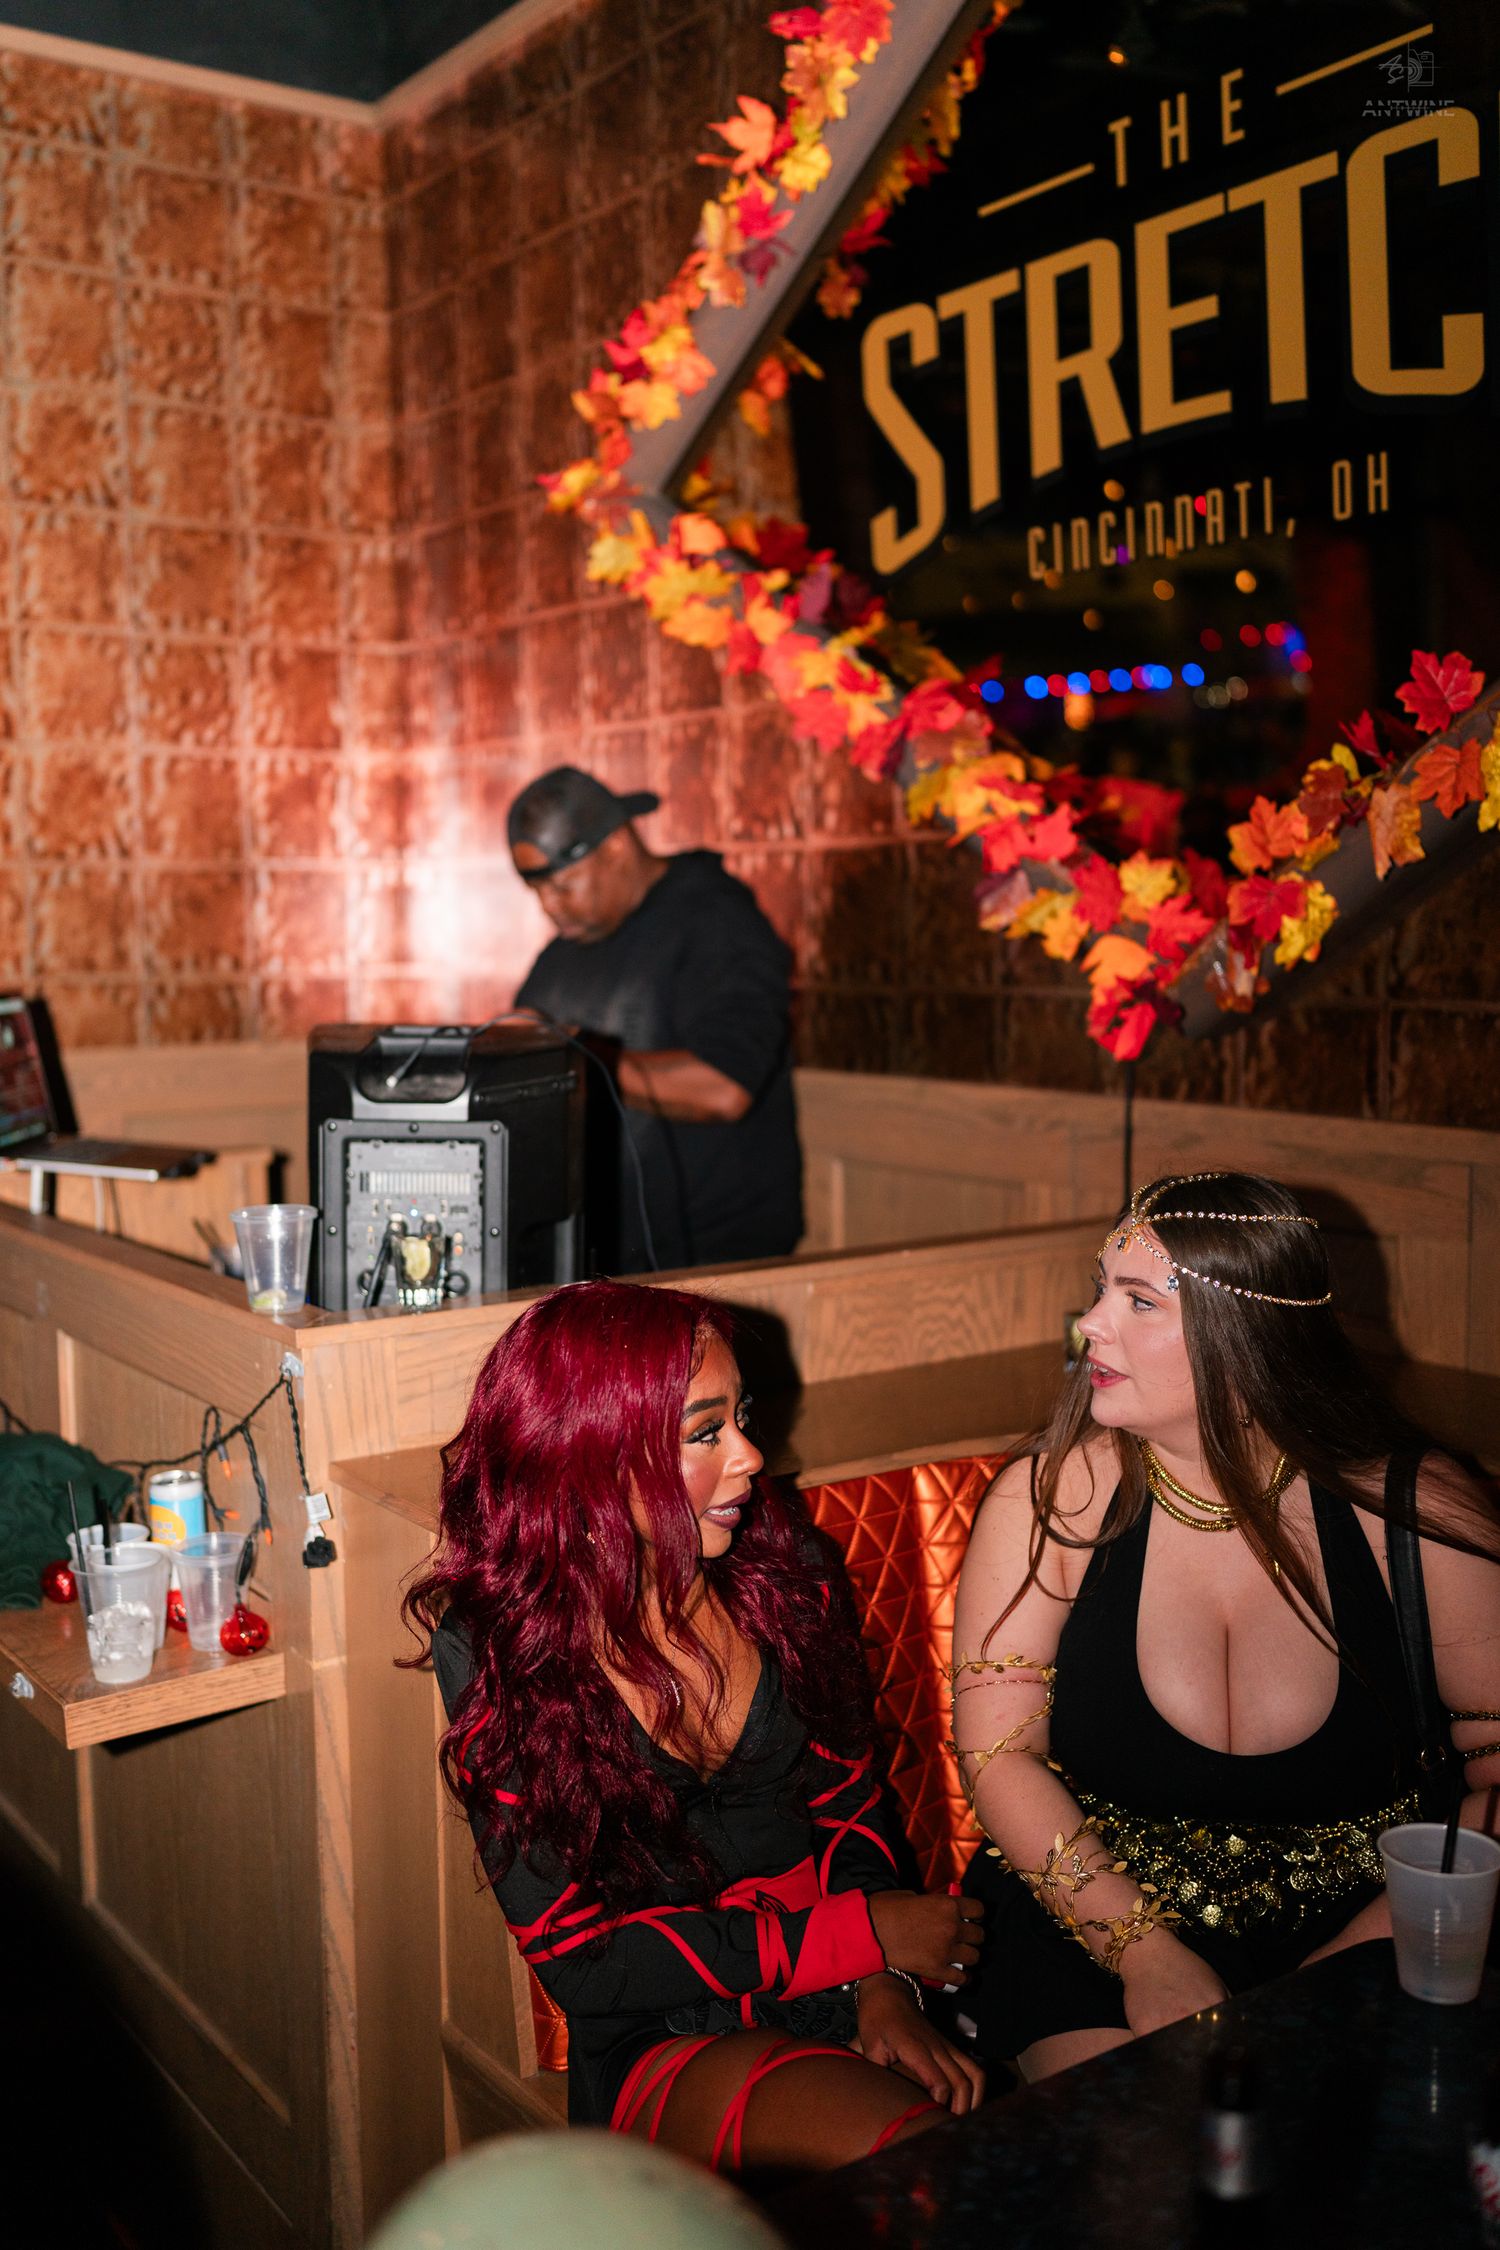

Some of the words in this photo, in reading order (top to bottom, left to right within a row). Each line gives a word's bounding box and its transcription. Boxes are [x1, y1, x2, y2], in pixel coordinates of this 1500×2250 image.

[1107, 67, 1246, 188] THE
[861, 90, 1500, 576] STRETC
[1331, 451, 1389, 521] OH
